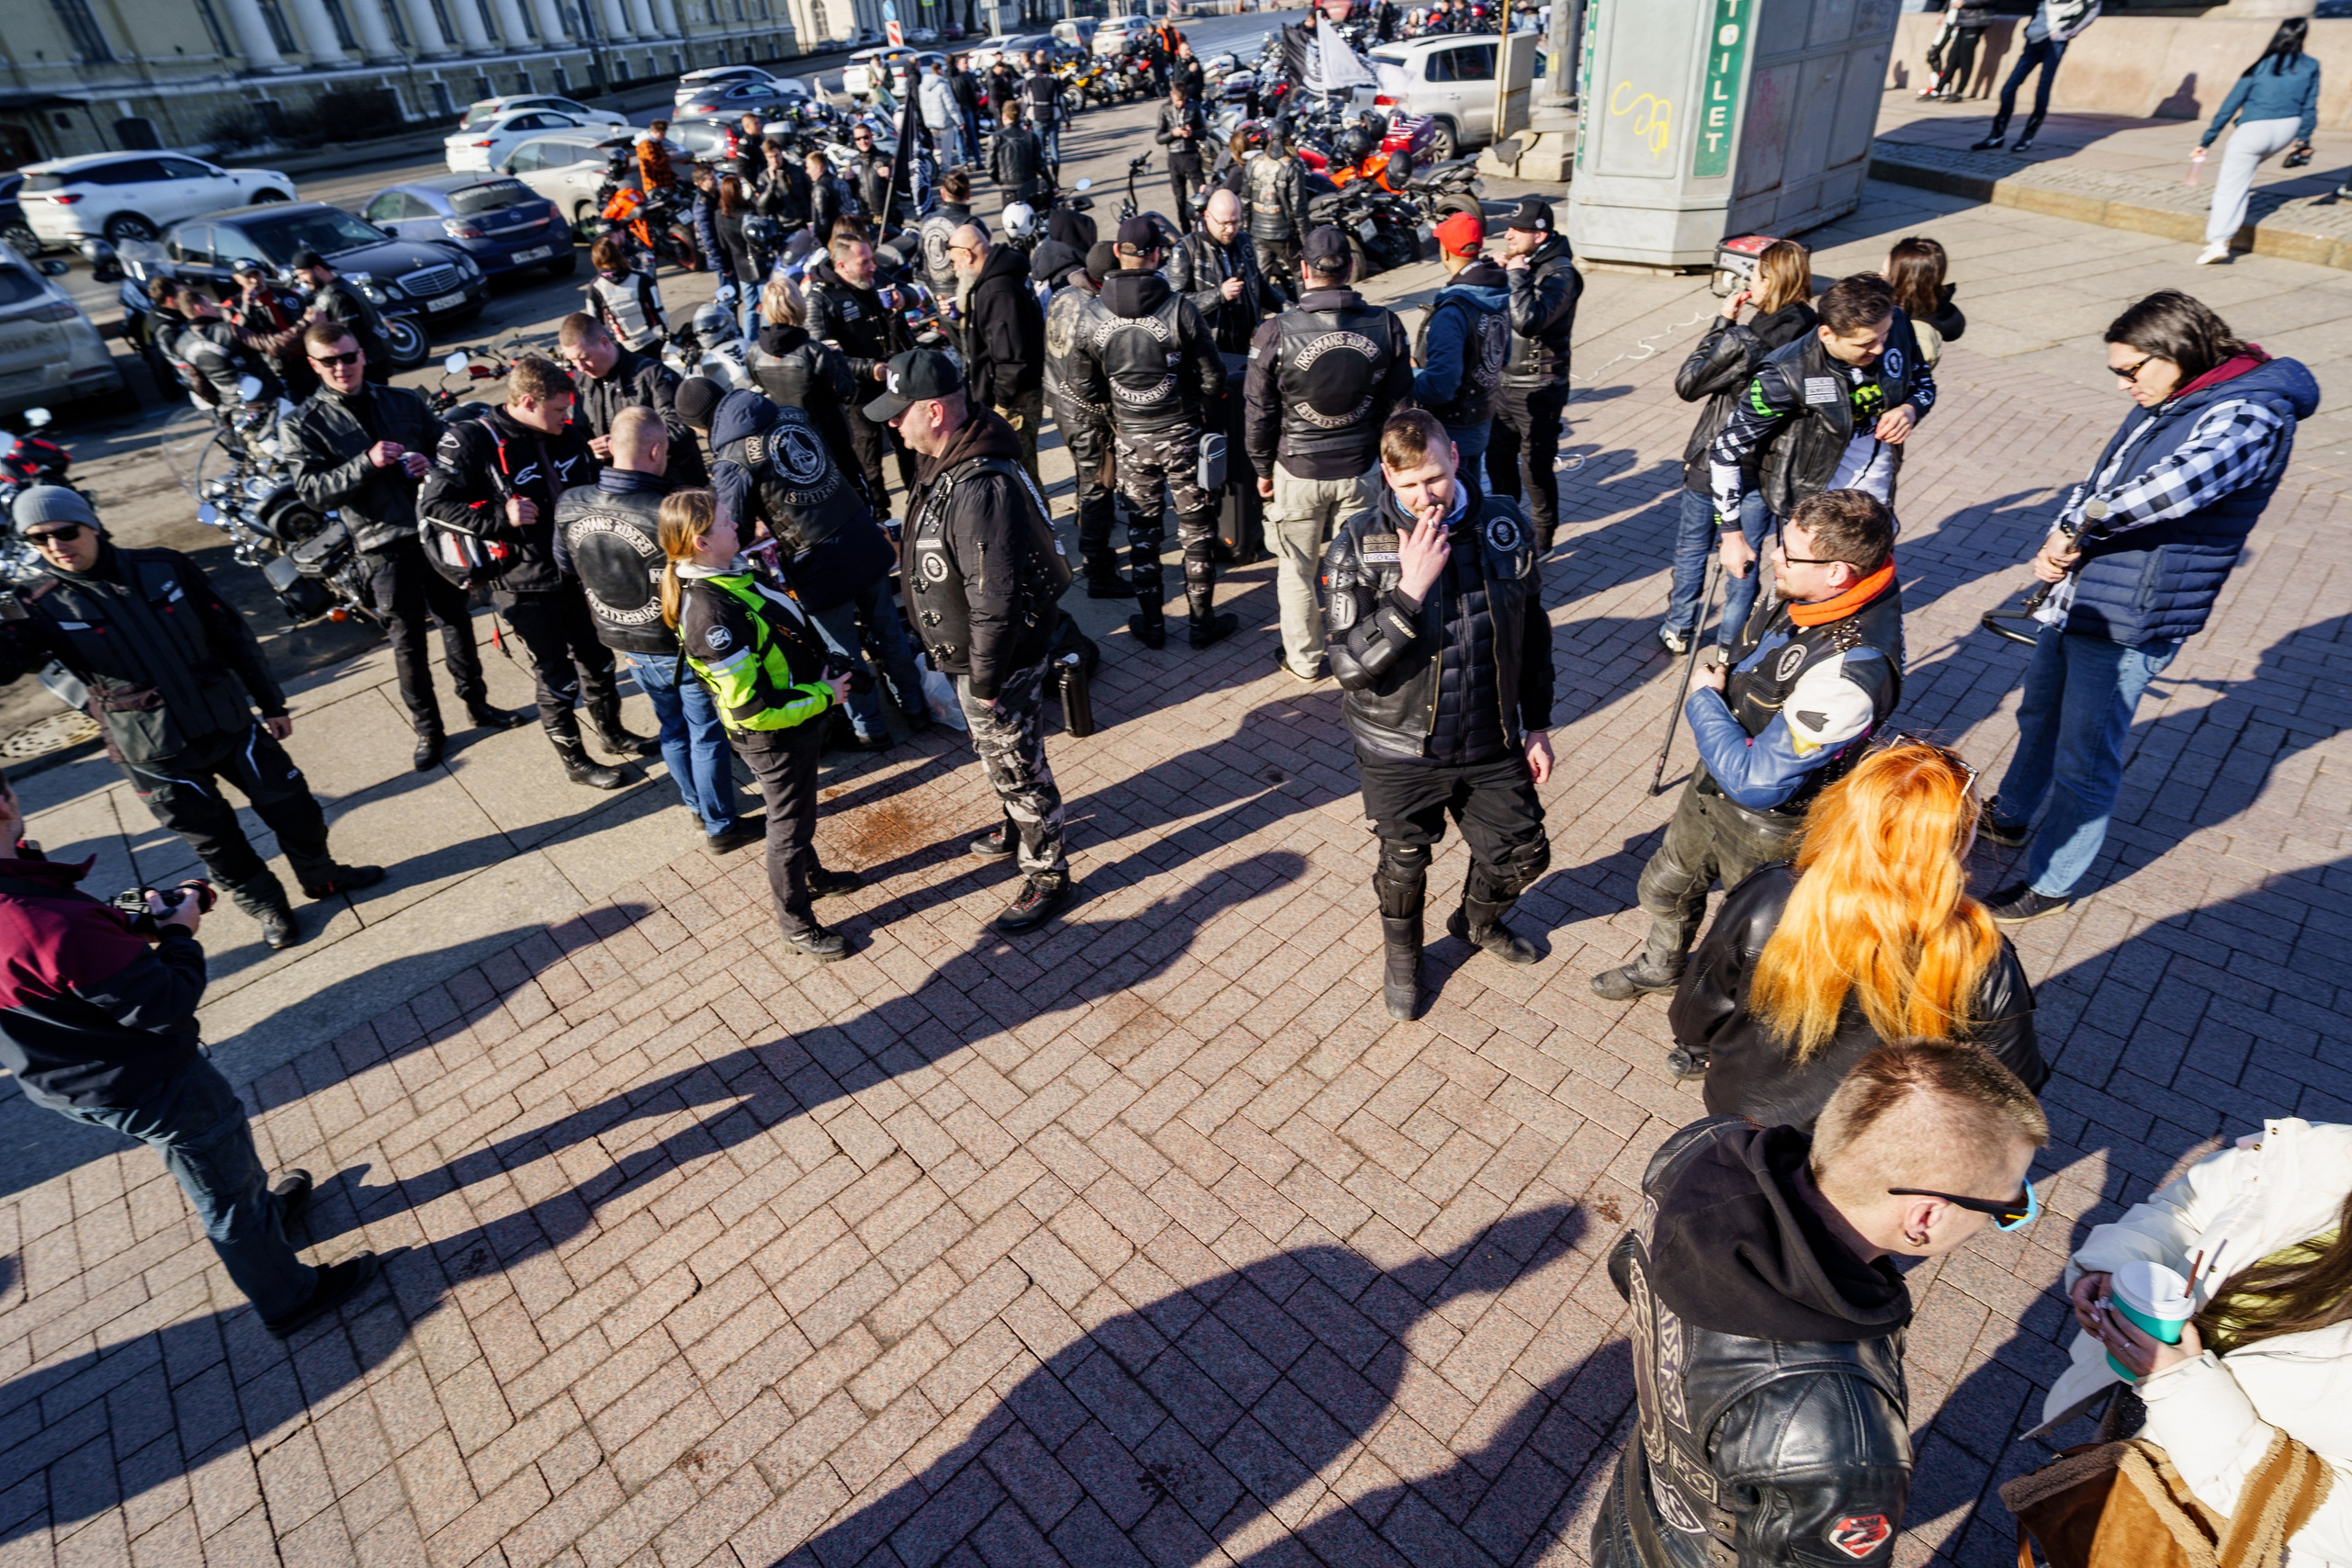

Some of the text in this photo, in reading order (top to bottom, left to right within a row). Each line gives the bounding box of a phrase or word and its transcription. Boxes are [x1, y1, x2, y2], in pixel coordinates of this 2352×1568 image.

[1705, 0, 1739, 152] TOILET
[1296, 333, 1378, 368] NORMANS RIDERS
[569, 516, 653, 555] NORMANS RIDERS
